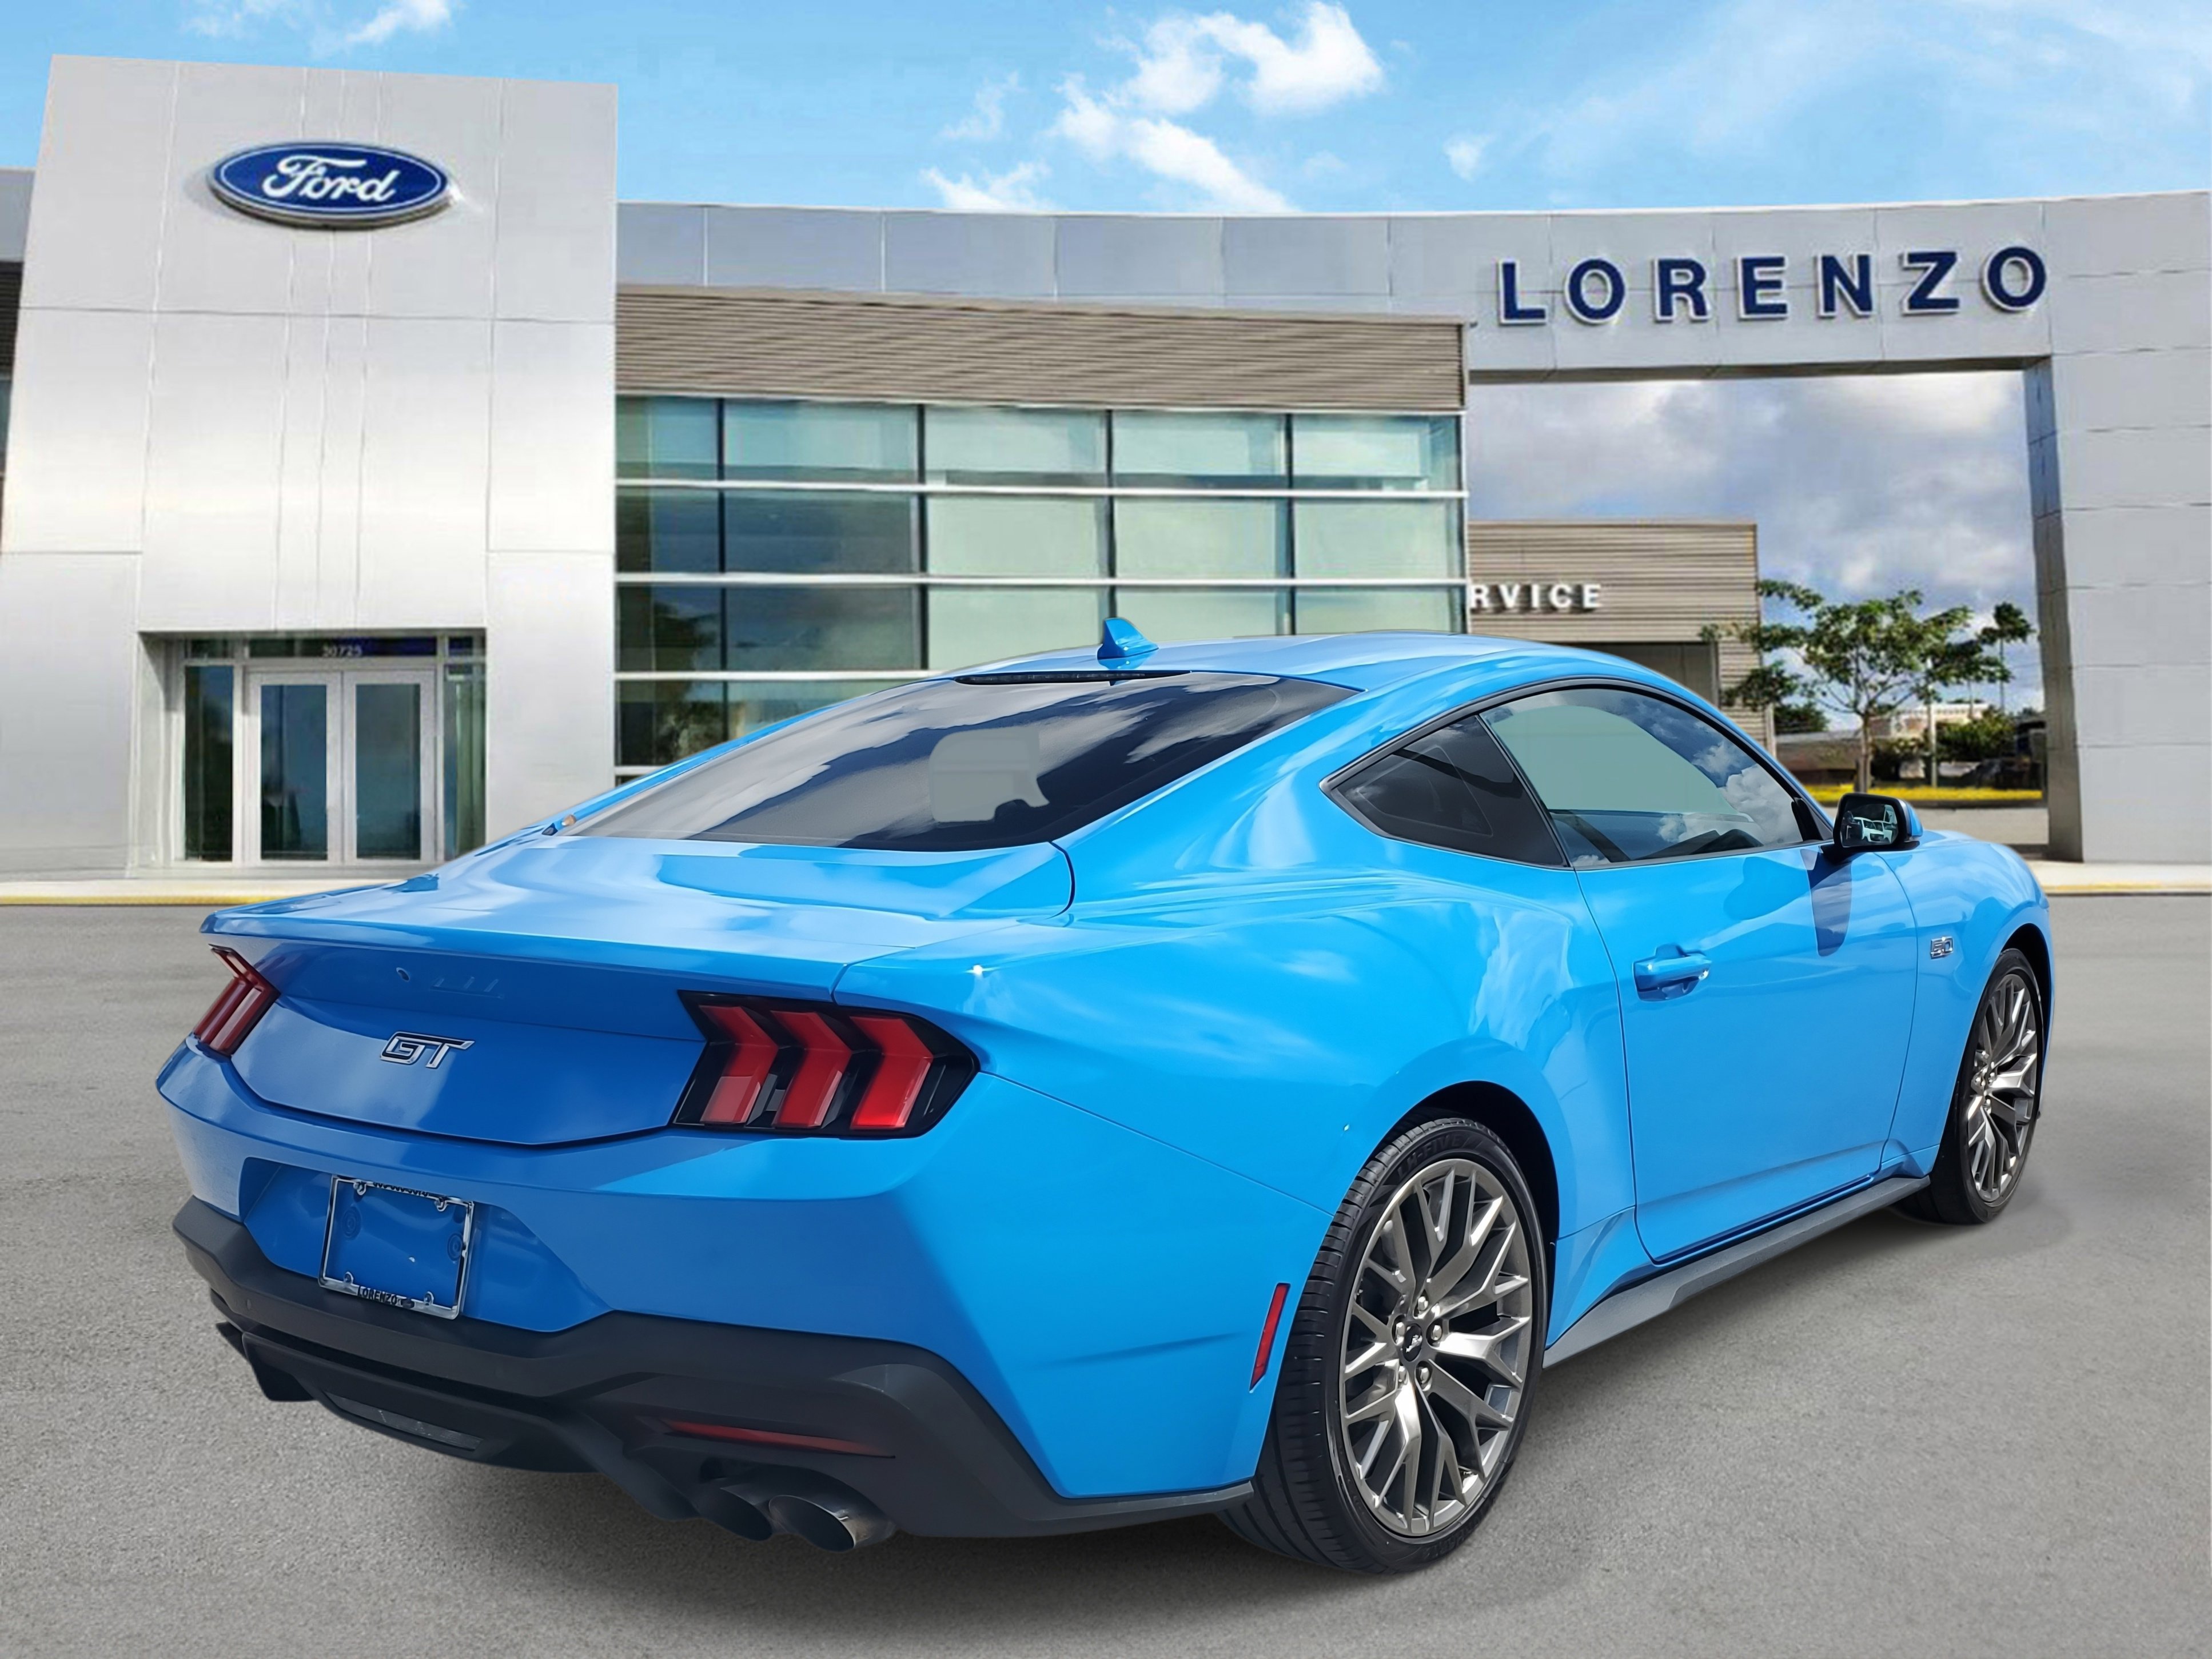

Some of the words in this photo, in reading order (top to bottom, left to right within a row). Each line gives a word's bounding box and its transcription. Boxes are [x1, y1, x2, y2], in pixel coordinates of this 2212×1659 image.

[261, 154, 400, 202] Ford
[1497, 246, 2047, 324] LORENZO
[380, 1031, 476, 1070] GT
[357, 1286, 397, 1306] LORENZO
